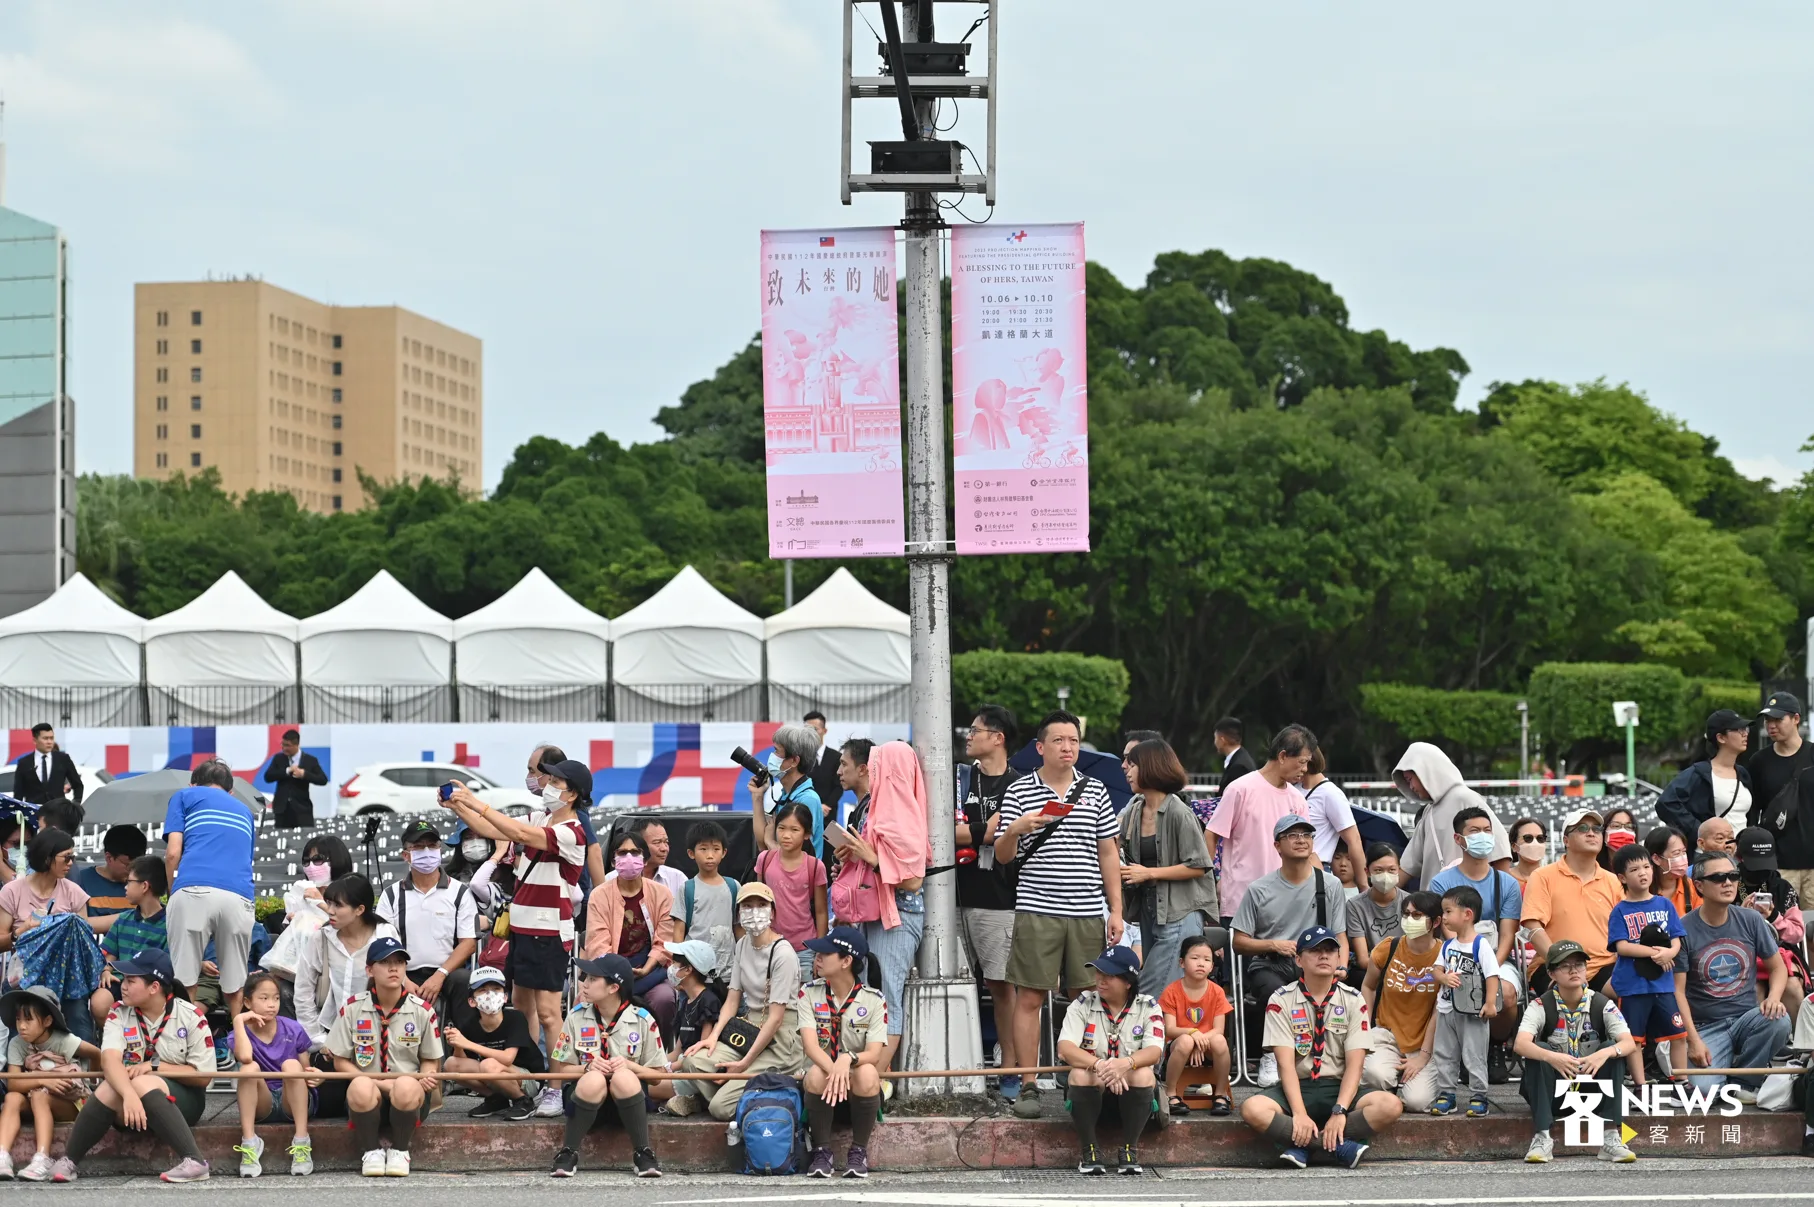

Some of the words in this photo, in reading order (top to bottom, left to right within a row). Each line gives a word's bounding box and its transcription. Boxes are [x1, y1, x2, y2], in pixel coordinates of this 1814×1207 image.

[767, 266, 890, 306] 致未來的她
[980, 295, 1010, 303] 10.06
[1024, 294, 1053, 302] 10.10
[981, 329, 1054, 340] 凱達格蘭大道
[1646, 911, 1668, 923] DERBY
[1390, 967, 1406, 981] TO
